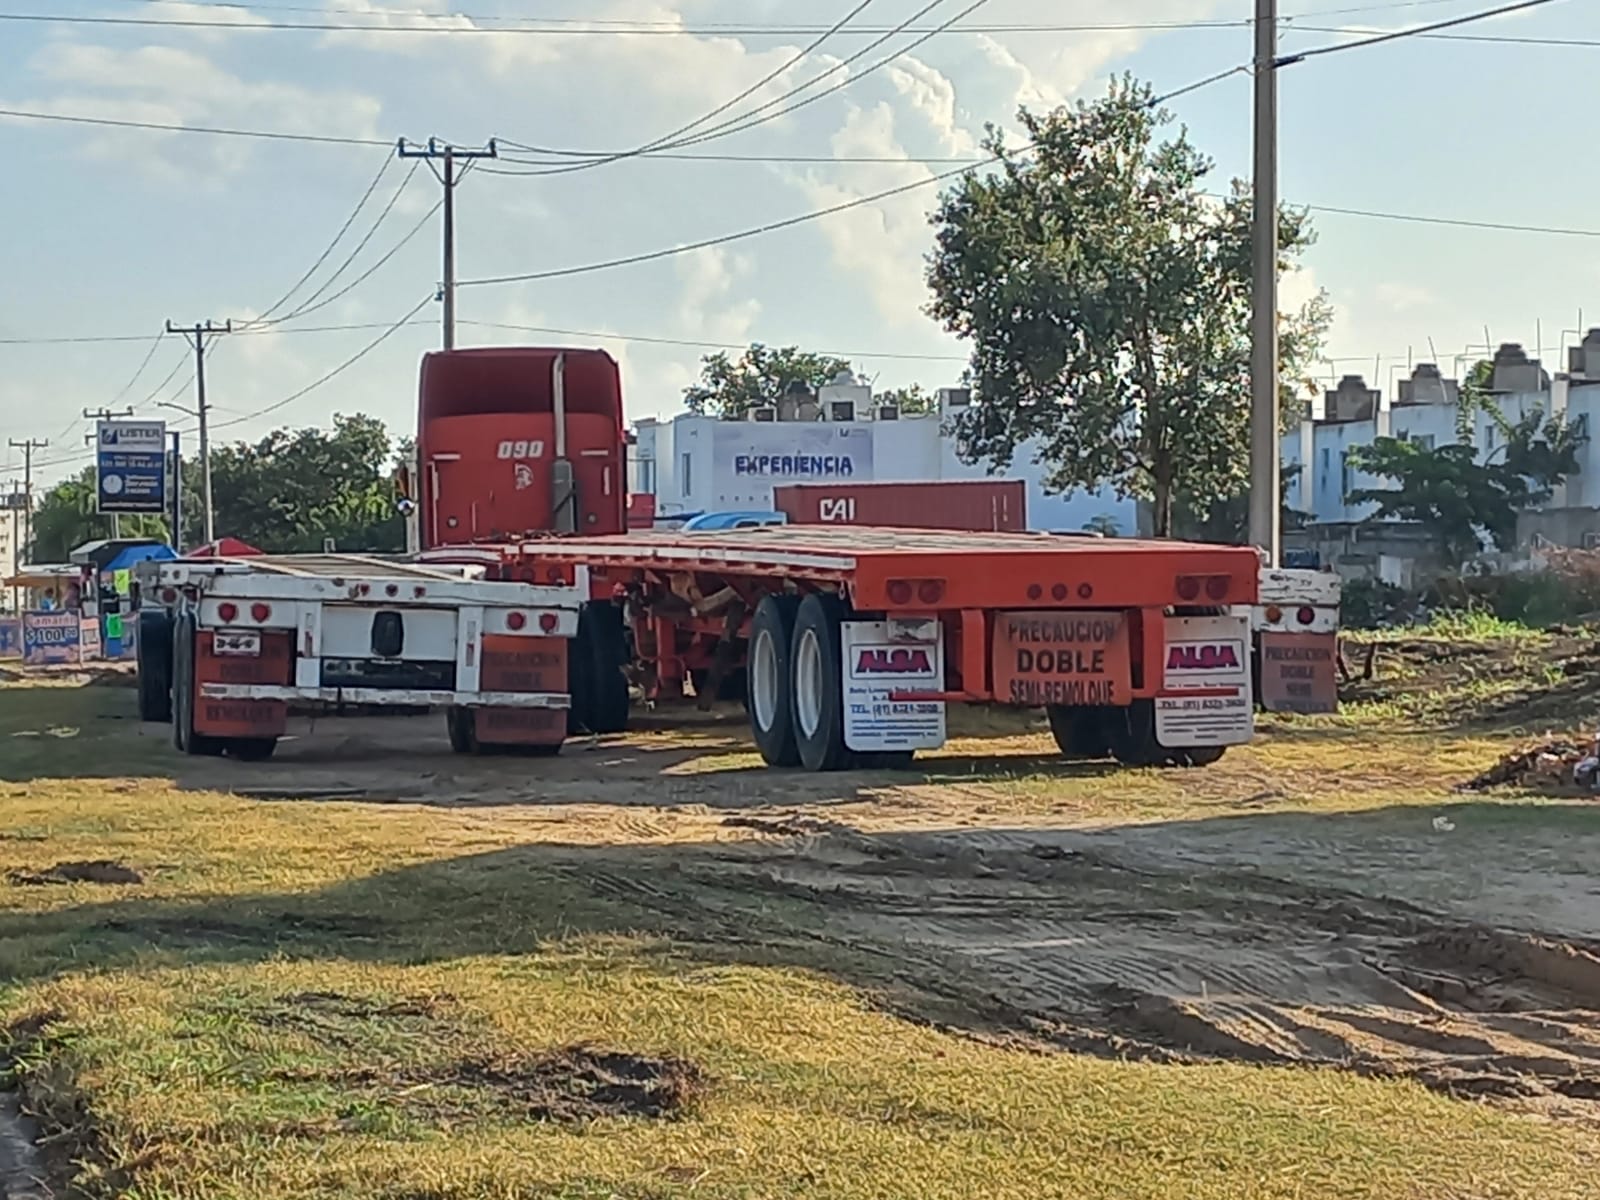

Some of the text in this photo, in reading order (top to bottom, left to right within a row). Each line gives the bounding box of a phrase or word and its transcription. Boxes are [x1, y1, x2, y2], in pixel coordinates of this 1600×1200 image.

[497, 440, 544, 459] 090
[735, 455, 853, 475] EXPERIENCIA
[819, 498, 856, 521] CAI
[1008, 619, 1115, 643] PRECAUCION
[1017, 648, 1104, 673] DOBLE
